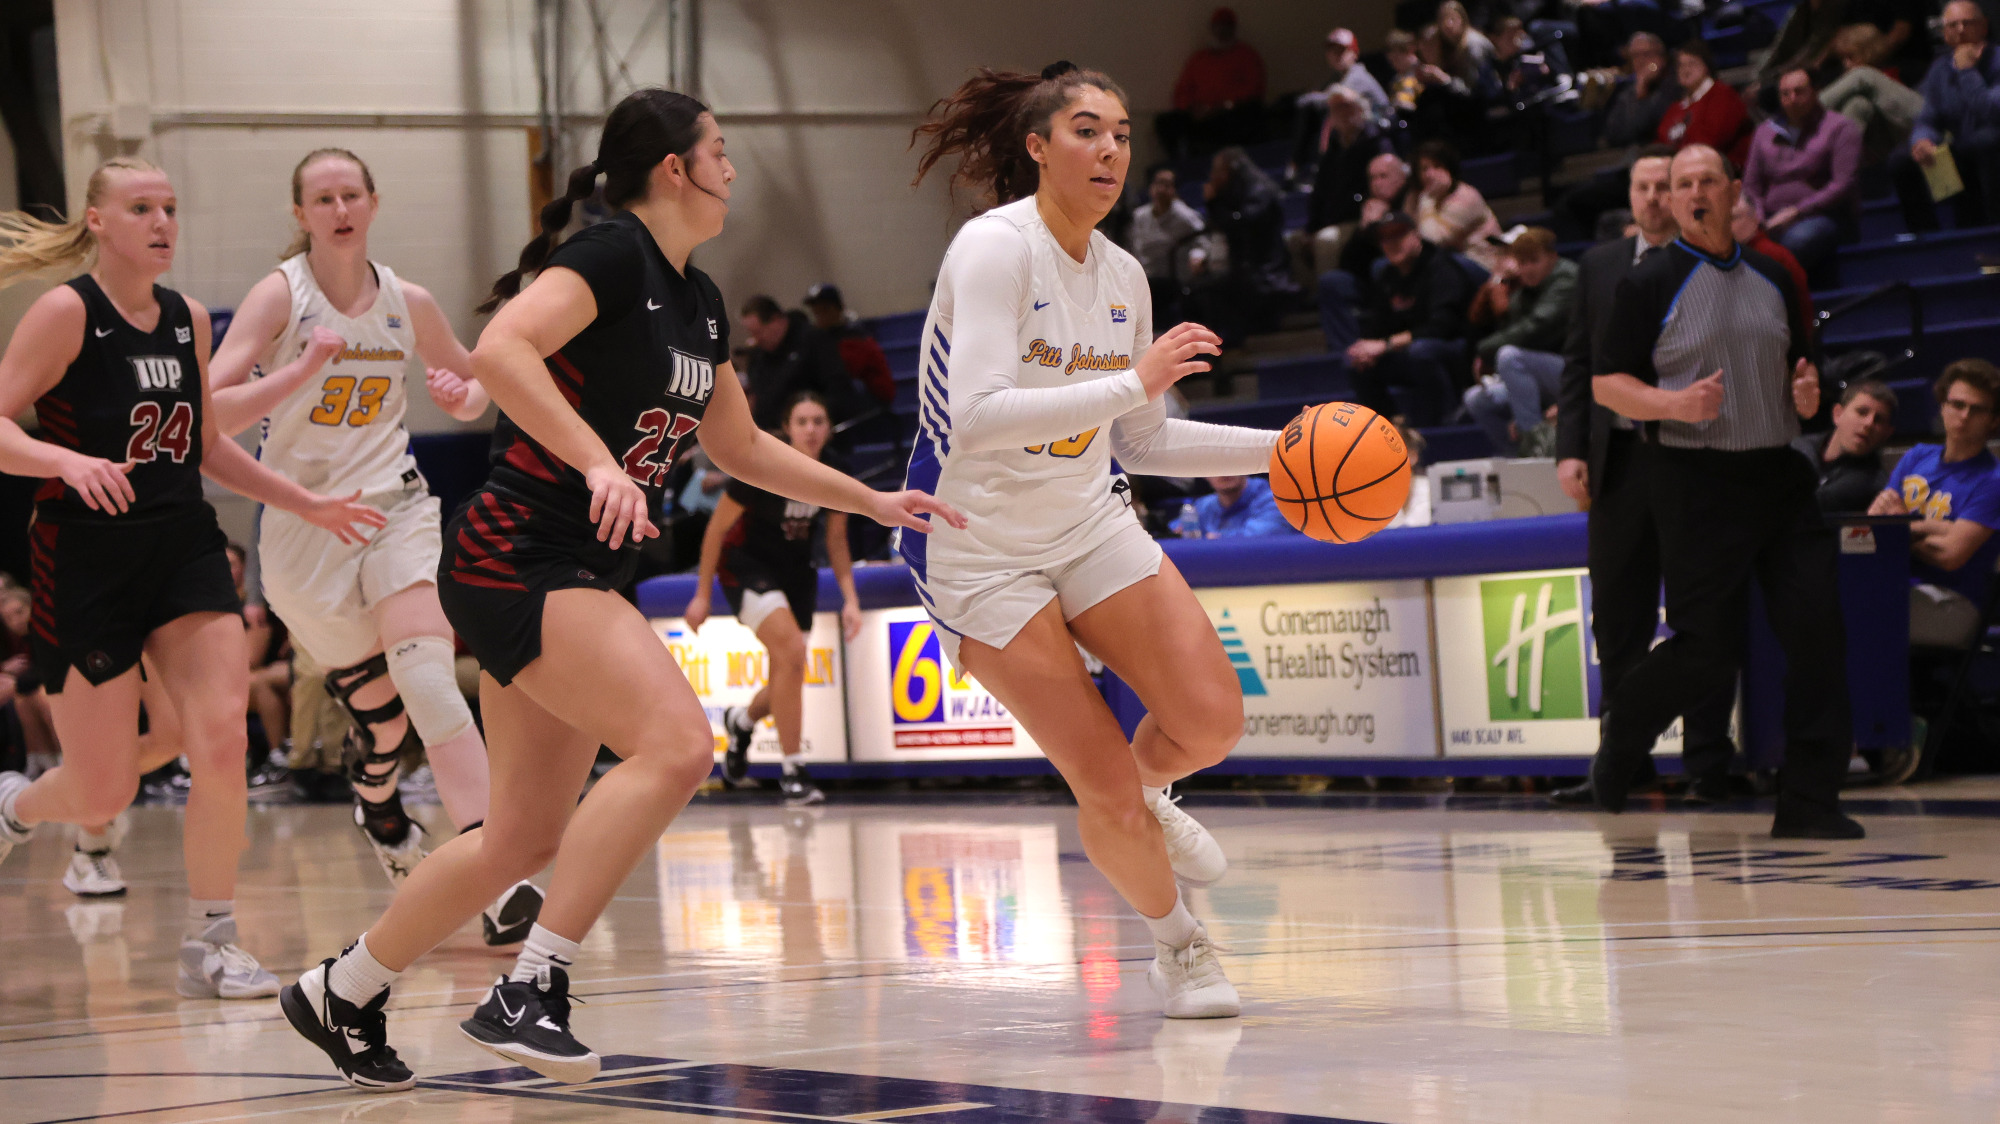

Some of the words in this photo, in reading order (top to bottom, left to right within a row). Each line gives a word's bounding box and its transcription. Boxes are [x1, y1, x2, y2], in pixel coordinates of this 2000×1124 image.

[132, 357, 182, 390] IUP
[668, 350, 714, 402] IUP
[1022, 338, 1062, 368] Pitt
[1064, 342, 1130, 376] Johnstown
[309, 375, 391, 427] 33
[126, 401, 193, 464] 24
[1260, 596, 1390, 645] Conemaugh
[892, 621, 941, 722] 6
[1265, 643, 1336, 680] Health
[1340, 642, 1421, 690] System
[1243, 707, 1375, 743] onemaugh.org
